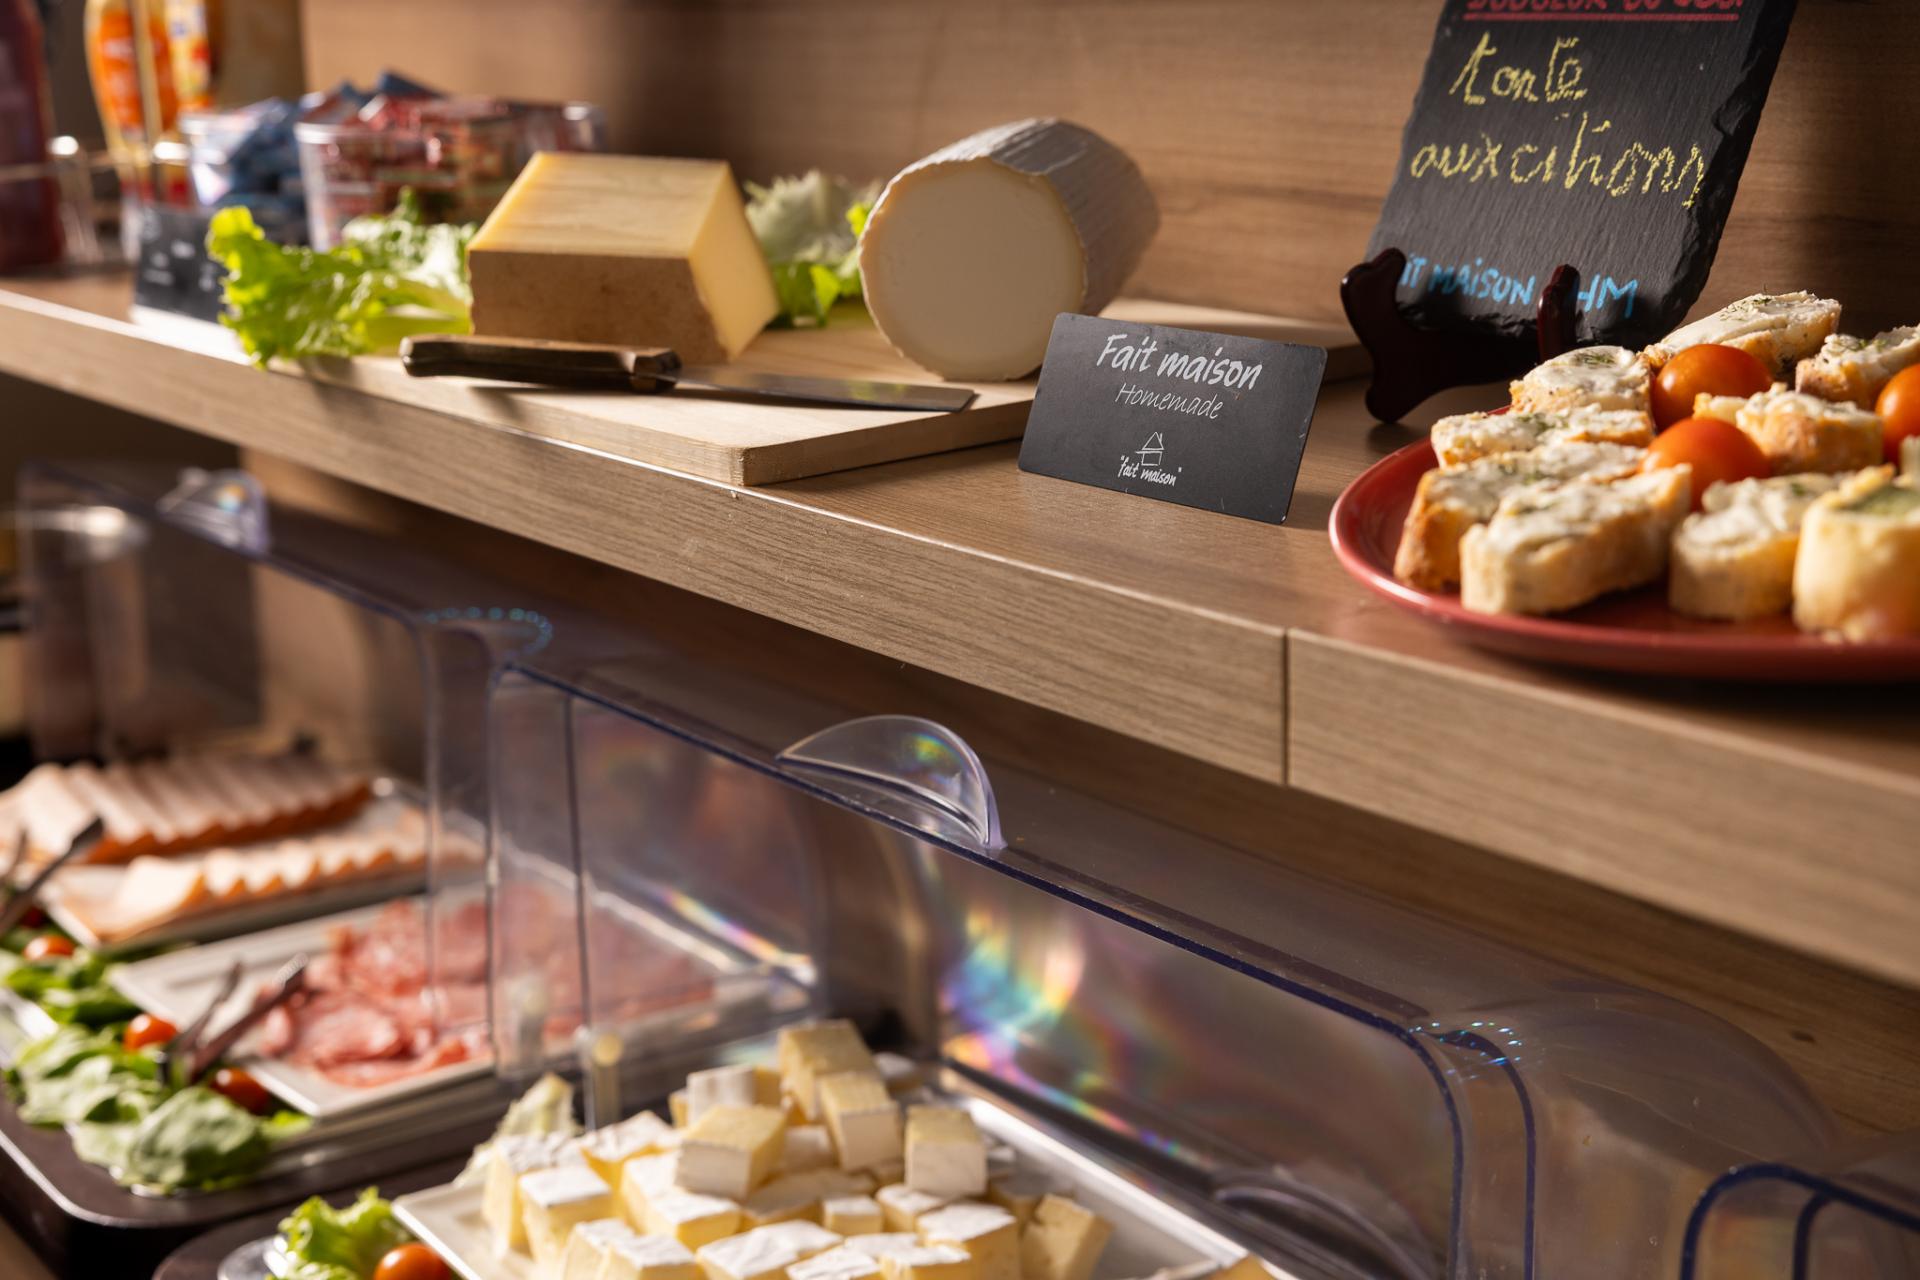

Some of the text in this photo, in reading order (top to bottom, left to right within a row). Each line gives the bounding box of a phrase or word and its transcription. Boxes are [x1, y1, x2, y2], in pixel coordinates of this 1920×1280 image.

[1410, 131, 1502, 183] aux
[1097, 333, 1263, 390] Fait maison
[1115, 382, 1224, 420] Homemade
